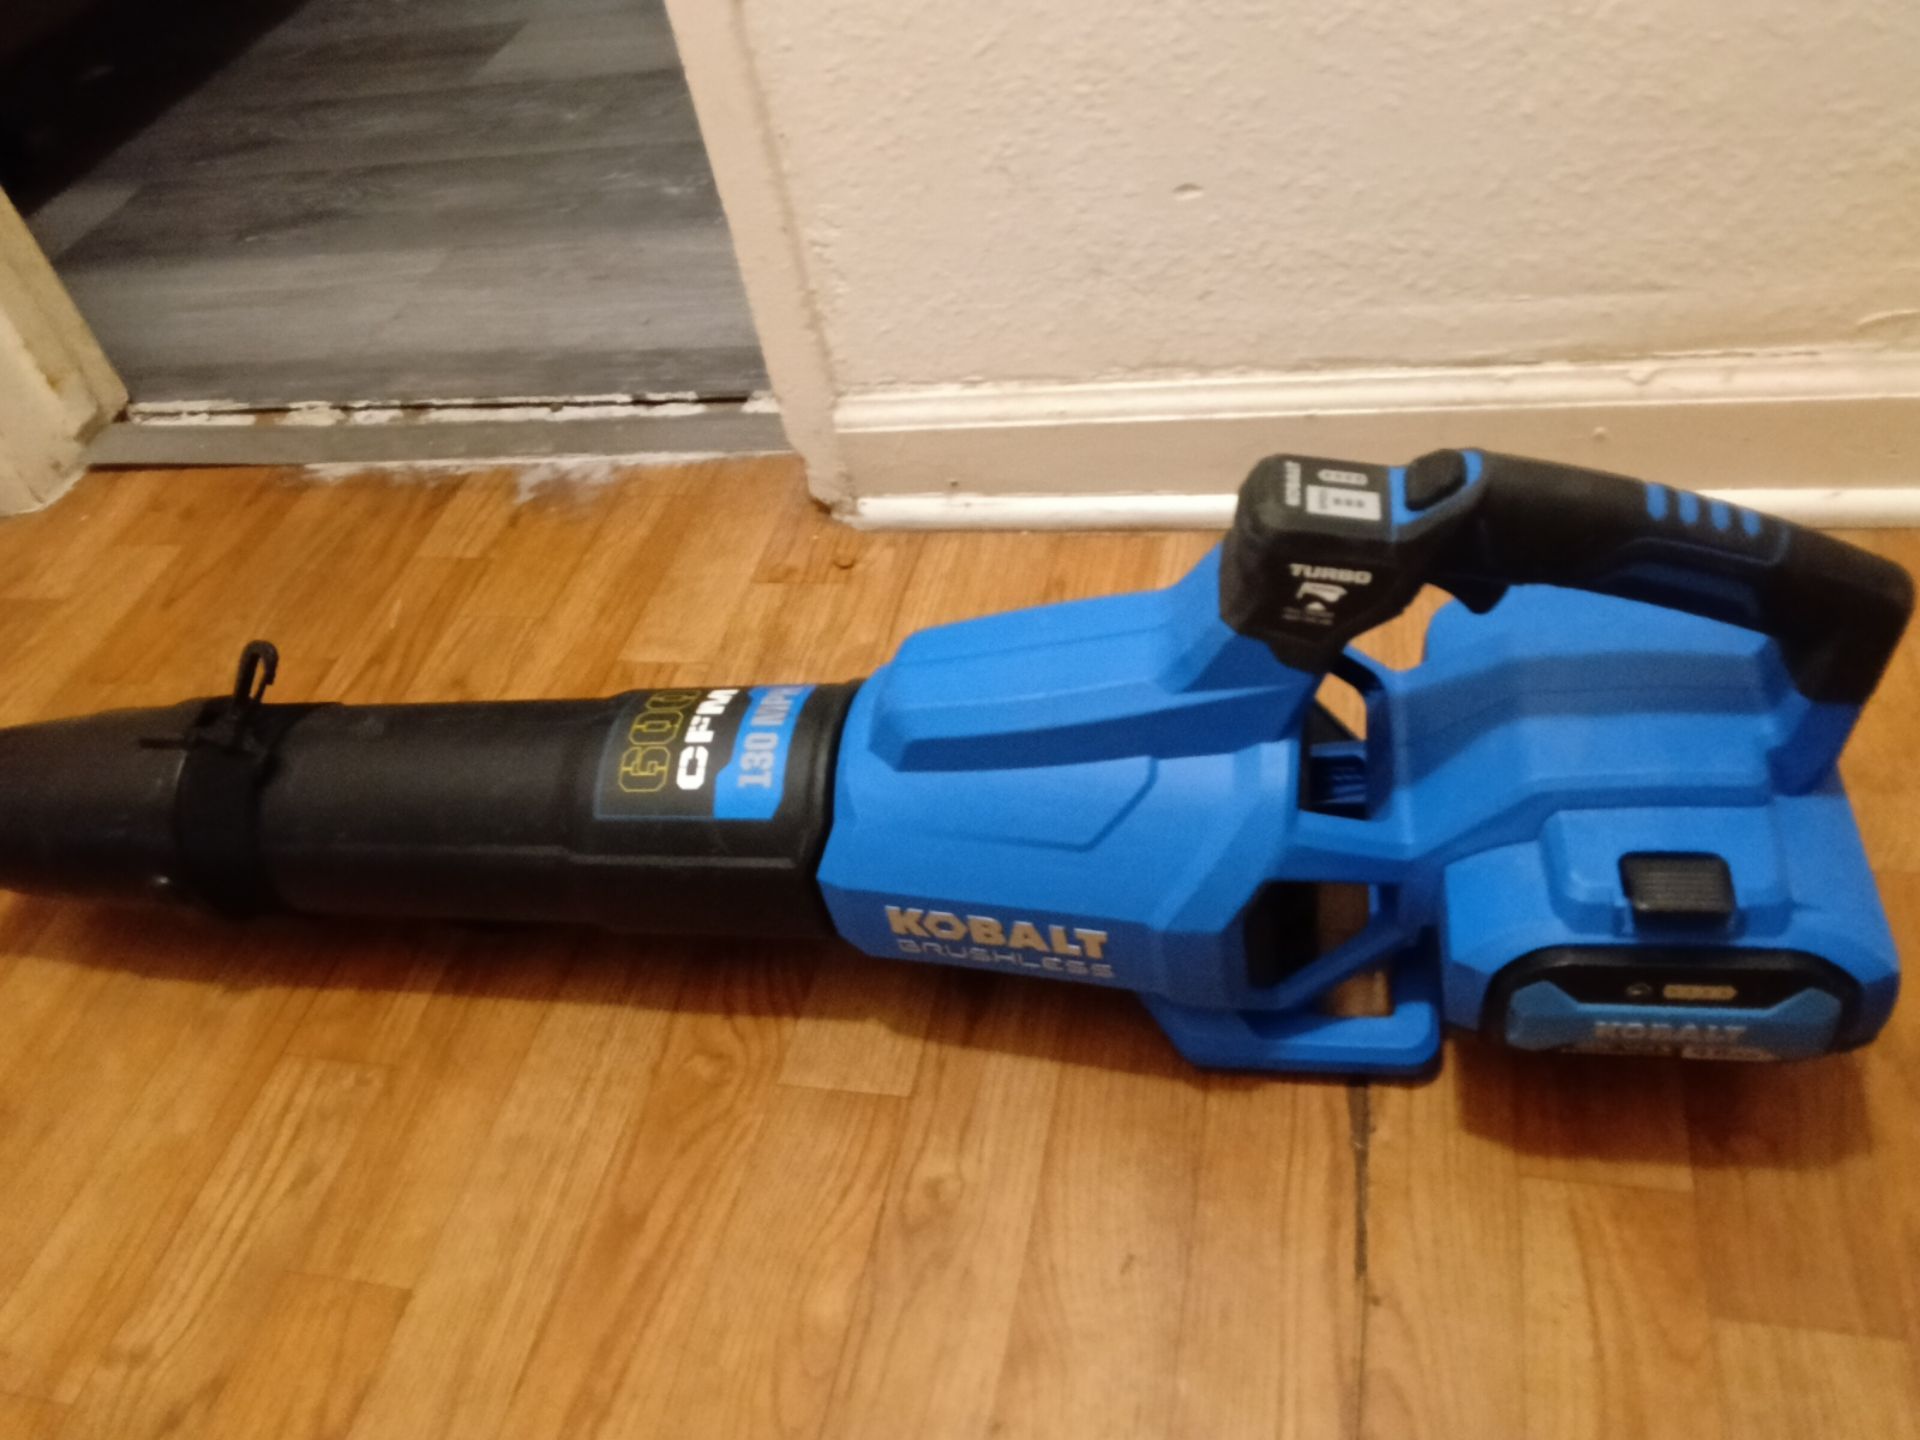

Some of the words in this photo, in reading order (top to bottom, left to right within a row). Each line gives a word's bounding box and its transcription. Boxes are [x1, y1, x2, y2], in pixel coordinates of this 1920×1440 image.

[1288, 563, 1373, 586] TURBO
[618, 689, 702, 793] 600
[676, 688, 740, 790] CFM
[737, 732, 779, 789] 130
[884, 905, 1108, 959] KOBALT
[897, 938, 1116, 978] BRUSHLESS
